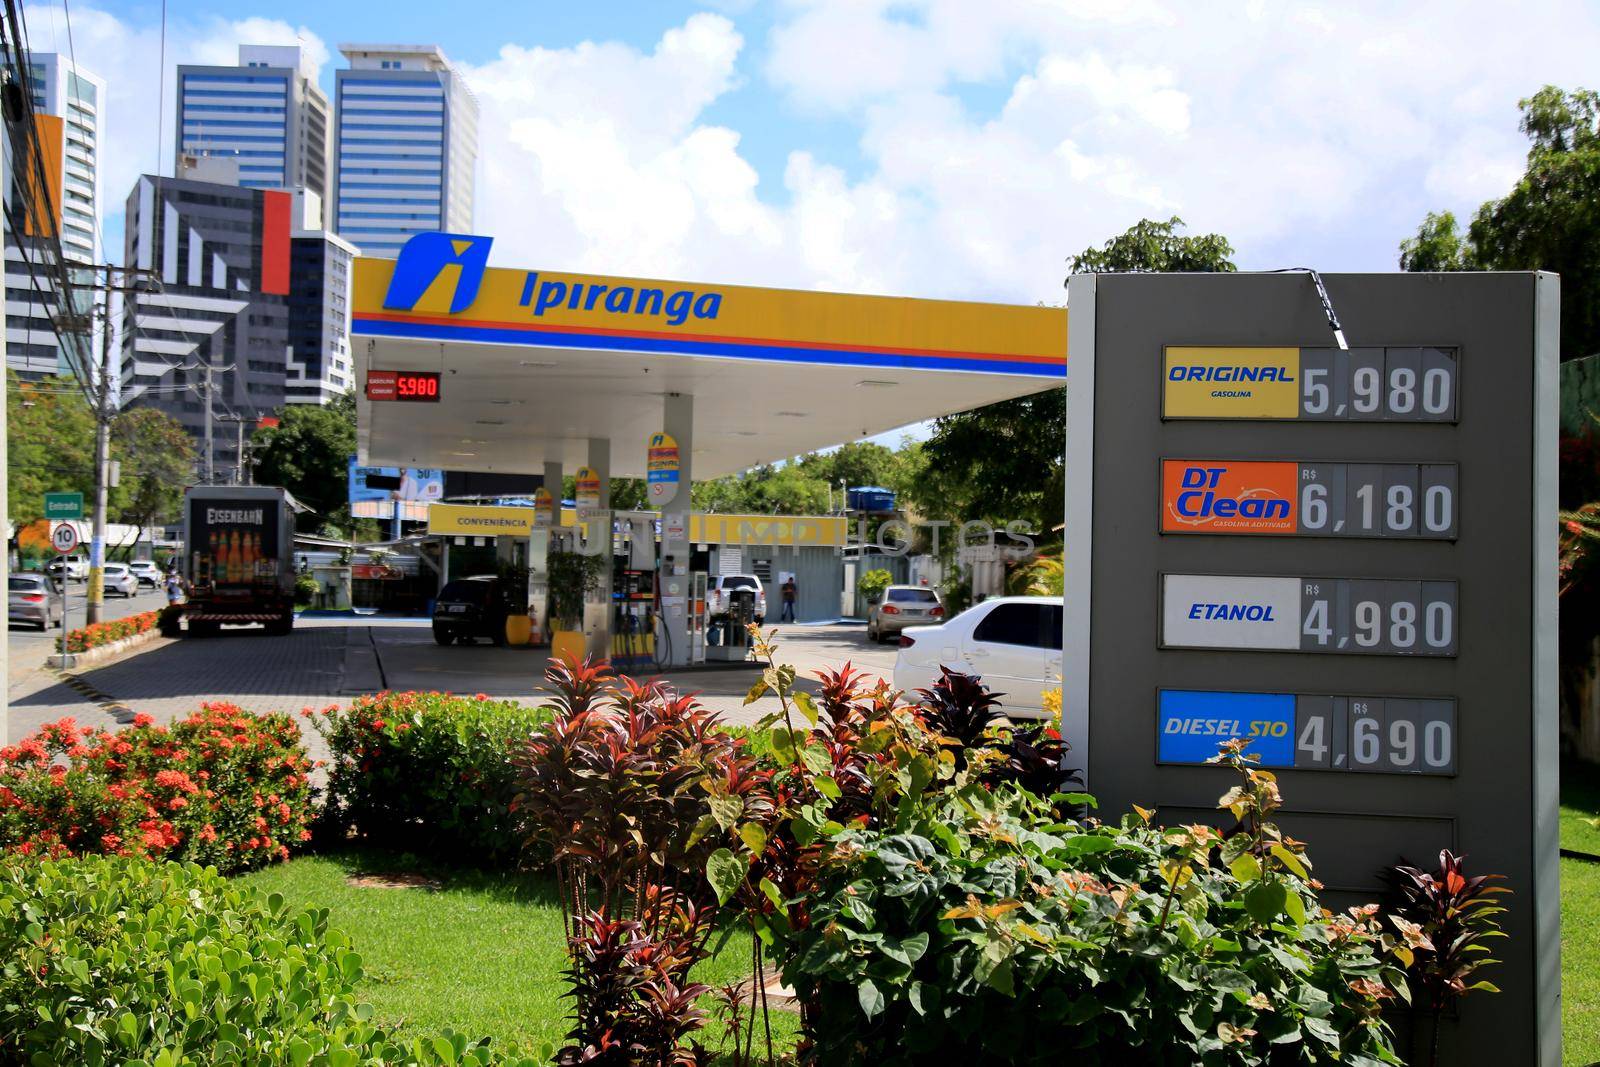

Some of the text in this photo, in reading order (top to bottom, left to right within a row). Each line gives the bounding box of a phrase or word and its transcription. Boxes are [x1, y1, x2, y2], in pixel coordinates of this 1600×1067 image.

[518, 271, 724, 326] Ipiranga
[1169, 366, 1294, 383] ORIGINAL
[1211, 390, 1252, 399] GASOLINA
[1303, 367, 1451, 416] 5,980
[1181, 467, 1228, 489] DT
[1301, 469, 1317, 481] R$
[1176, 490, 1291, 519] Clean
[1301, 483, 1453, 533] 6,180
[206, 508, 264, 525] EISENBAHN
[457, 516, 528, 528] CONVENIÊNCIA
[1213, 520, 1292, 529] GASOLINA ADITIVADA
[57, 529, 72, 543] 10
[1305, 584, 1320, 596] R$
[1188, 603, 1275, 623] ETANOL
[1302, 600, 1453, 649] 4,980
[1353, 702, 1368, 715] R$
[1164, 718, 1289, 738] DIESEL S10
[1297, 715, 1452, 767] 4,690
